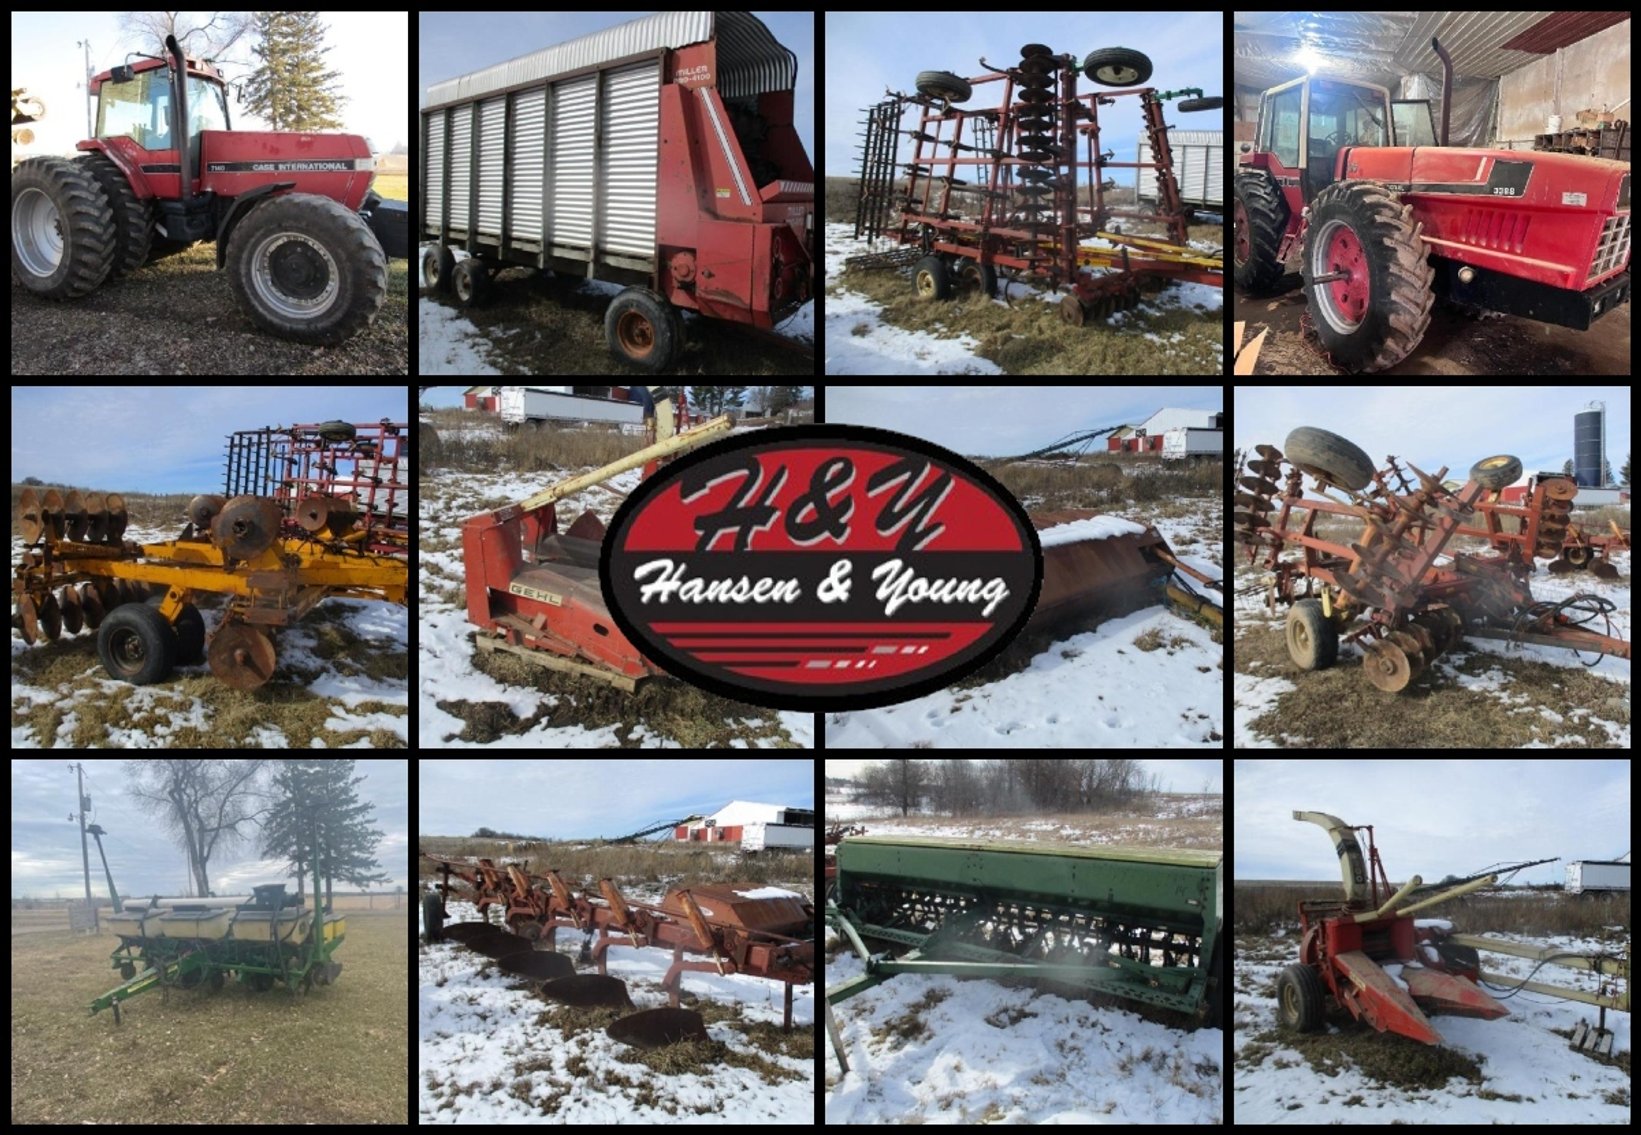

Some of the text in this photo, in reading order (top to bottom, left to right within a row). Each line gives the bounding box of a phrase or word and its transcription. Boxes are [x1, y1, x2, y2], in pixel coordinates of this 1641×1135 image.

[675, 65, 708, 76] MILLER
[252, 162, 348, 171] CASE INTERNATIONAL
[511, 584, 560, 605] GEHL
